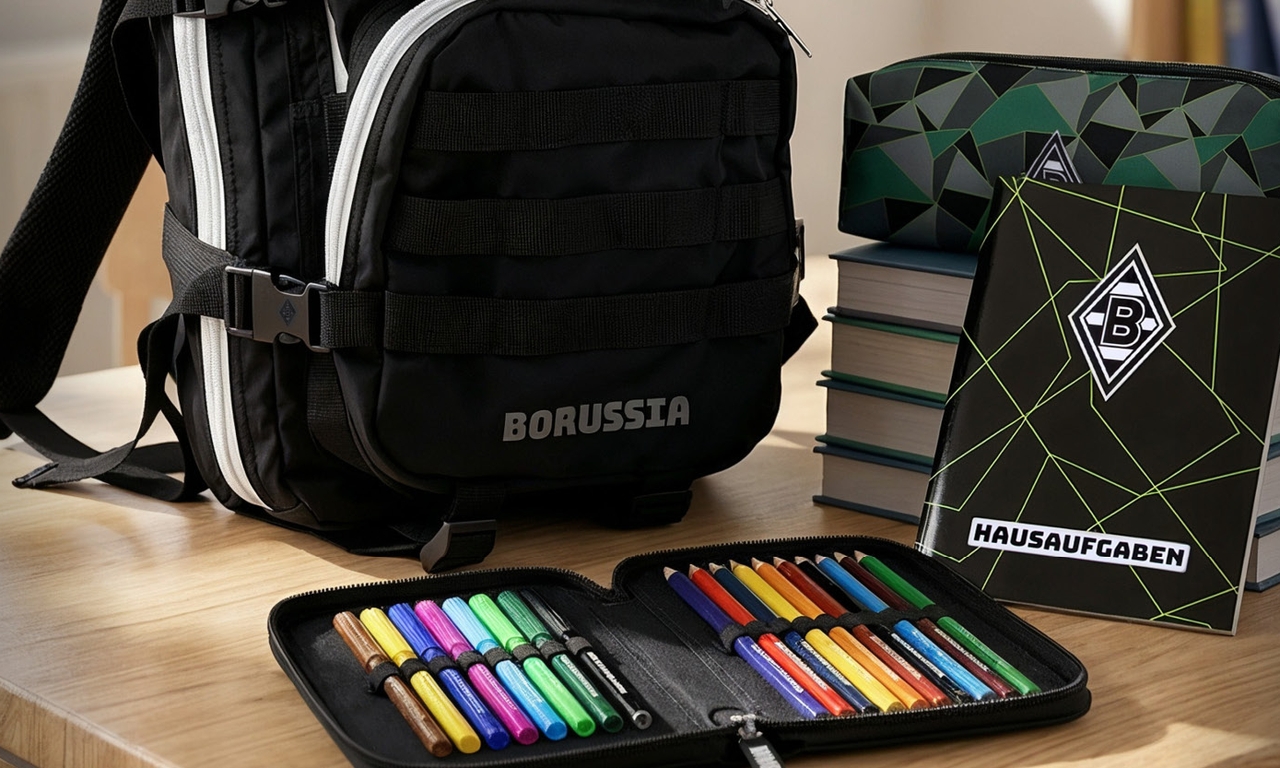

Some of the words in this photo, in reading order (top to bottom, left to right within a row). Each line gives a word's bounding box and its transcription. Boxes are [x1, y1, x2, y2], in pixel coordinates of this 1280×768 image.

[1100, 295, 1146, 347] B
[503, 396, 690, 441] BORUSSIA
[974, 523, 1184, 566] HAUSAUFGABEN
